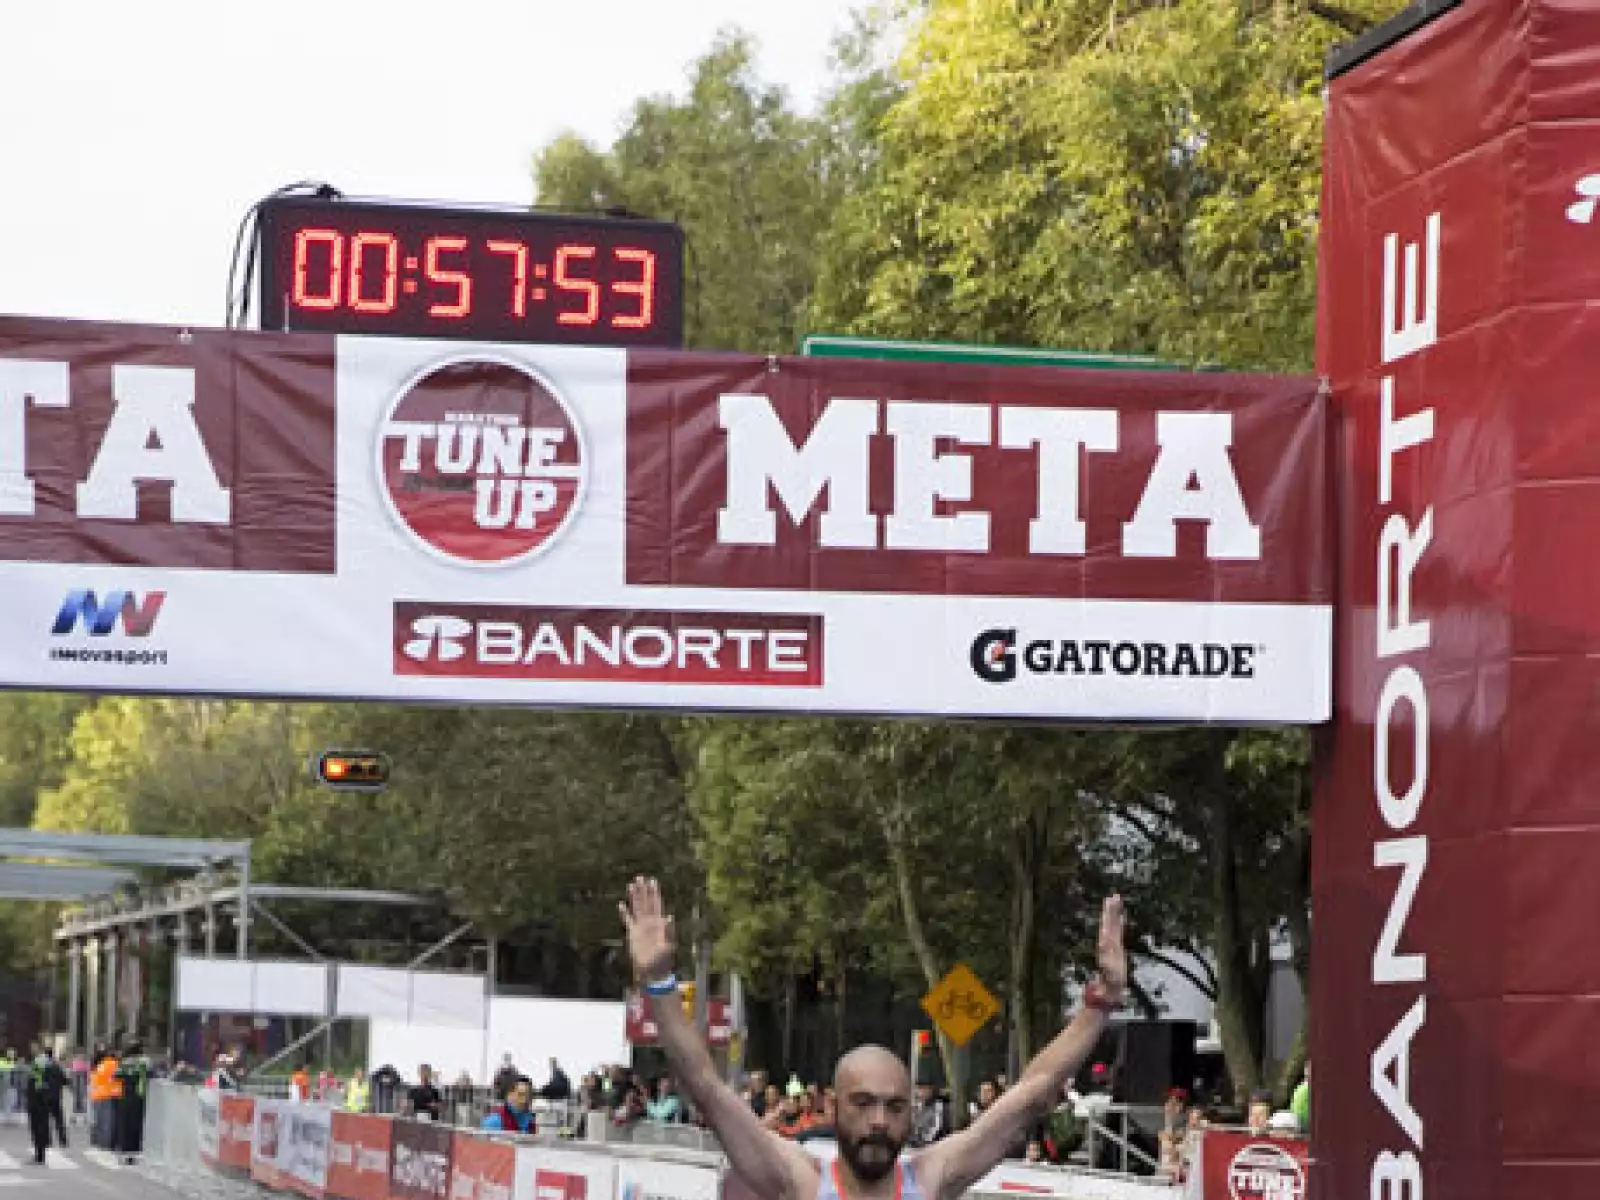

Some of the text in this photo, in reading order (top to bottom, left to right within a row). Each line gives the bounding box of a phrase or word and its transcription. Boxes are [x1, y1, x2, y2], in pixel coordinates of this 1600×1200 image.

[293, 229, 656, 328] 00:57:53
[382, 421, 583, 477] TUNE
[717, 392, 1261, 560] META
[474, 479, 558, 530] UP
[476, 621, 809, 673] BANORTE
[1022, 639, 1256, 679] GATORADE
